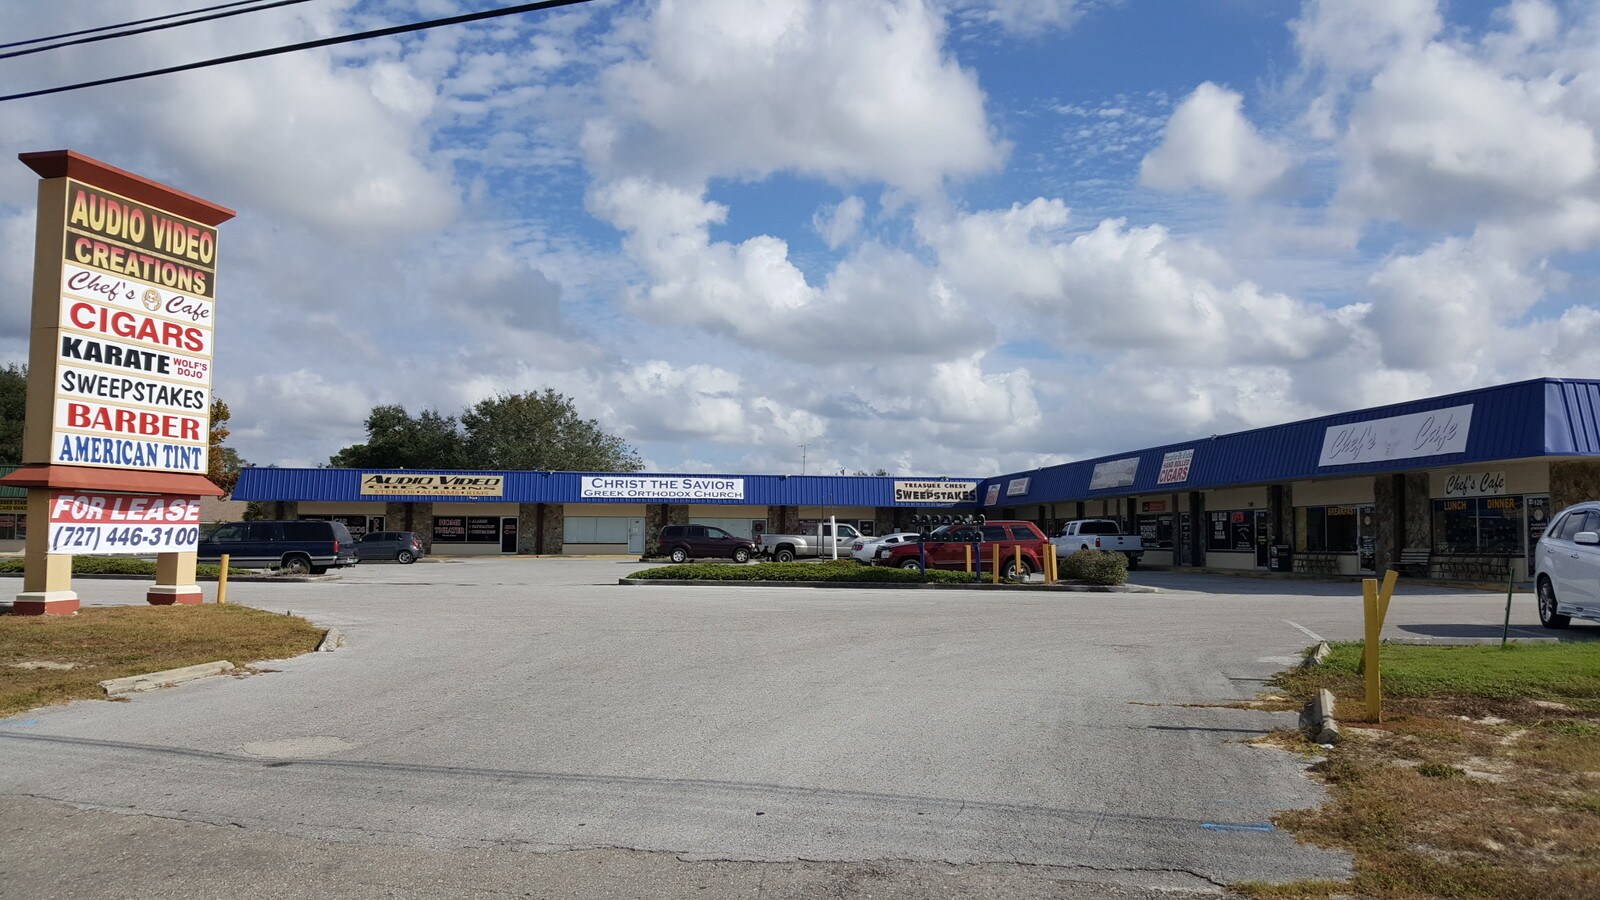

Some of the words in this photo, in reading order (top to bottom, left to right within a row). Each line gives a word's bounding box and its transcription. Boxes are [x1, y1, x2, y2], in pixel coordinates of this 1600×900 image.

[71, 190, 145, 243] AUDIO
[152, 215, 214, 264] VIDEO
[75, 238, 206, 295] CREATIONS
[67, 271, 135, 301] Chef's
[166, 296, 209, 321] Cafe
[70, 302, 204, 351] CIGARS
[62, 336, 170, 375] KARATE
[173, 357, 208, 372] WOLF'S
[177, 368, 203, 379] DOJO
[61, 370, 204, 409] SWEEPSTAKES
[67, 403, 200, 440] BARBER
[1328, 426, 1376, 460] Chef's
[1413, 414, 1458, 452] Cafe
[59, 435, 158, 467] AMERICAN
[163, 444, 201, 470] TINT
[364, 475, 434, 484] AUDIO
[439, 476, 500, 485] VIDEO
[592, 478, 647, 489] CHRIST
[650, 480, 678, 489] THE
[682, 479, 735, 490] SAVIOR
[1159, 466, 1188, 482] CIGARS
[1446, 475, 1476, 496] Chef's
[1480, 473, 1504, 493] Cafe
[694, 490, 742, 498] CHURCH
[896, 489, 976, 501] SWEEPSTAKES
[1444, 500, 1467, 511] LUNCH
[1487, 498, 1515, 509] DINNER
[52, 495, 106, 520] FOR
[110, 497, 200, 521] LEASE
[1328, 507, 1356, 516] BREAKFAST
[53, 526, 100, 550] (727)
[106, 527, 198, 546] 446-3100
